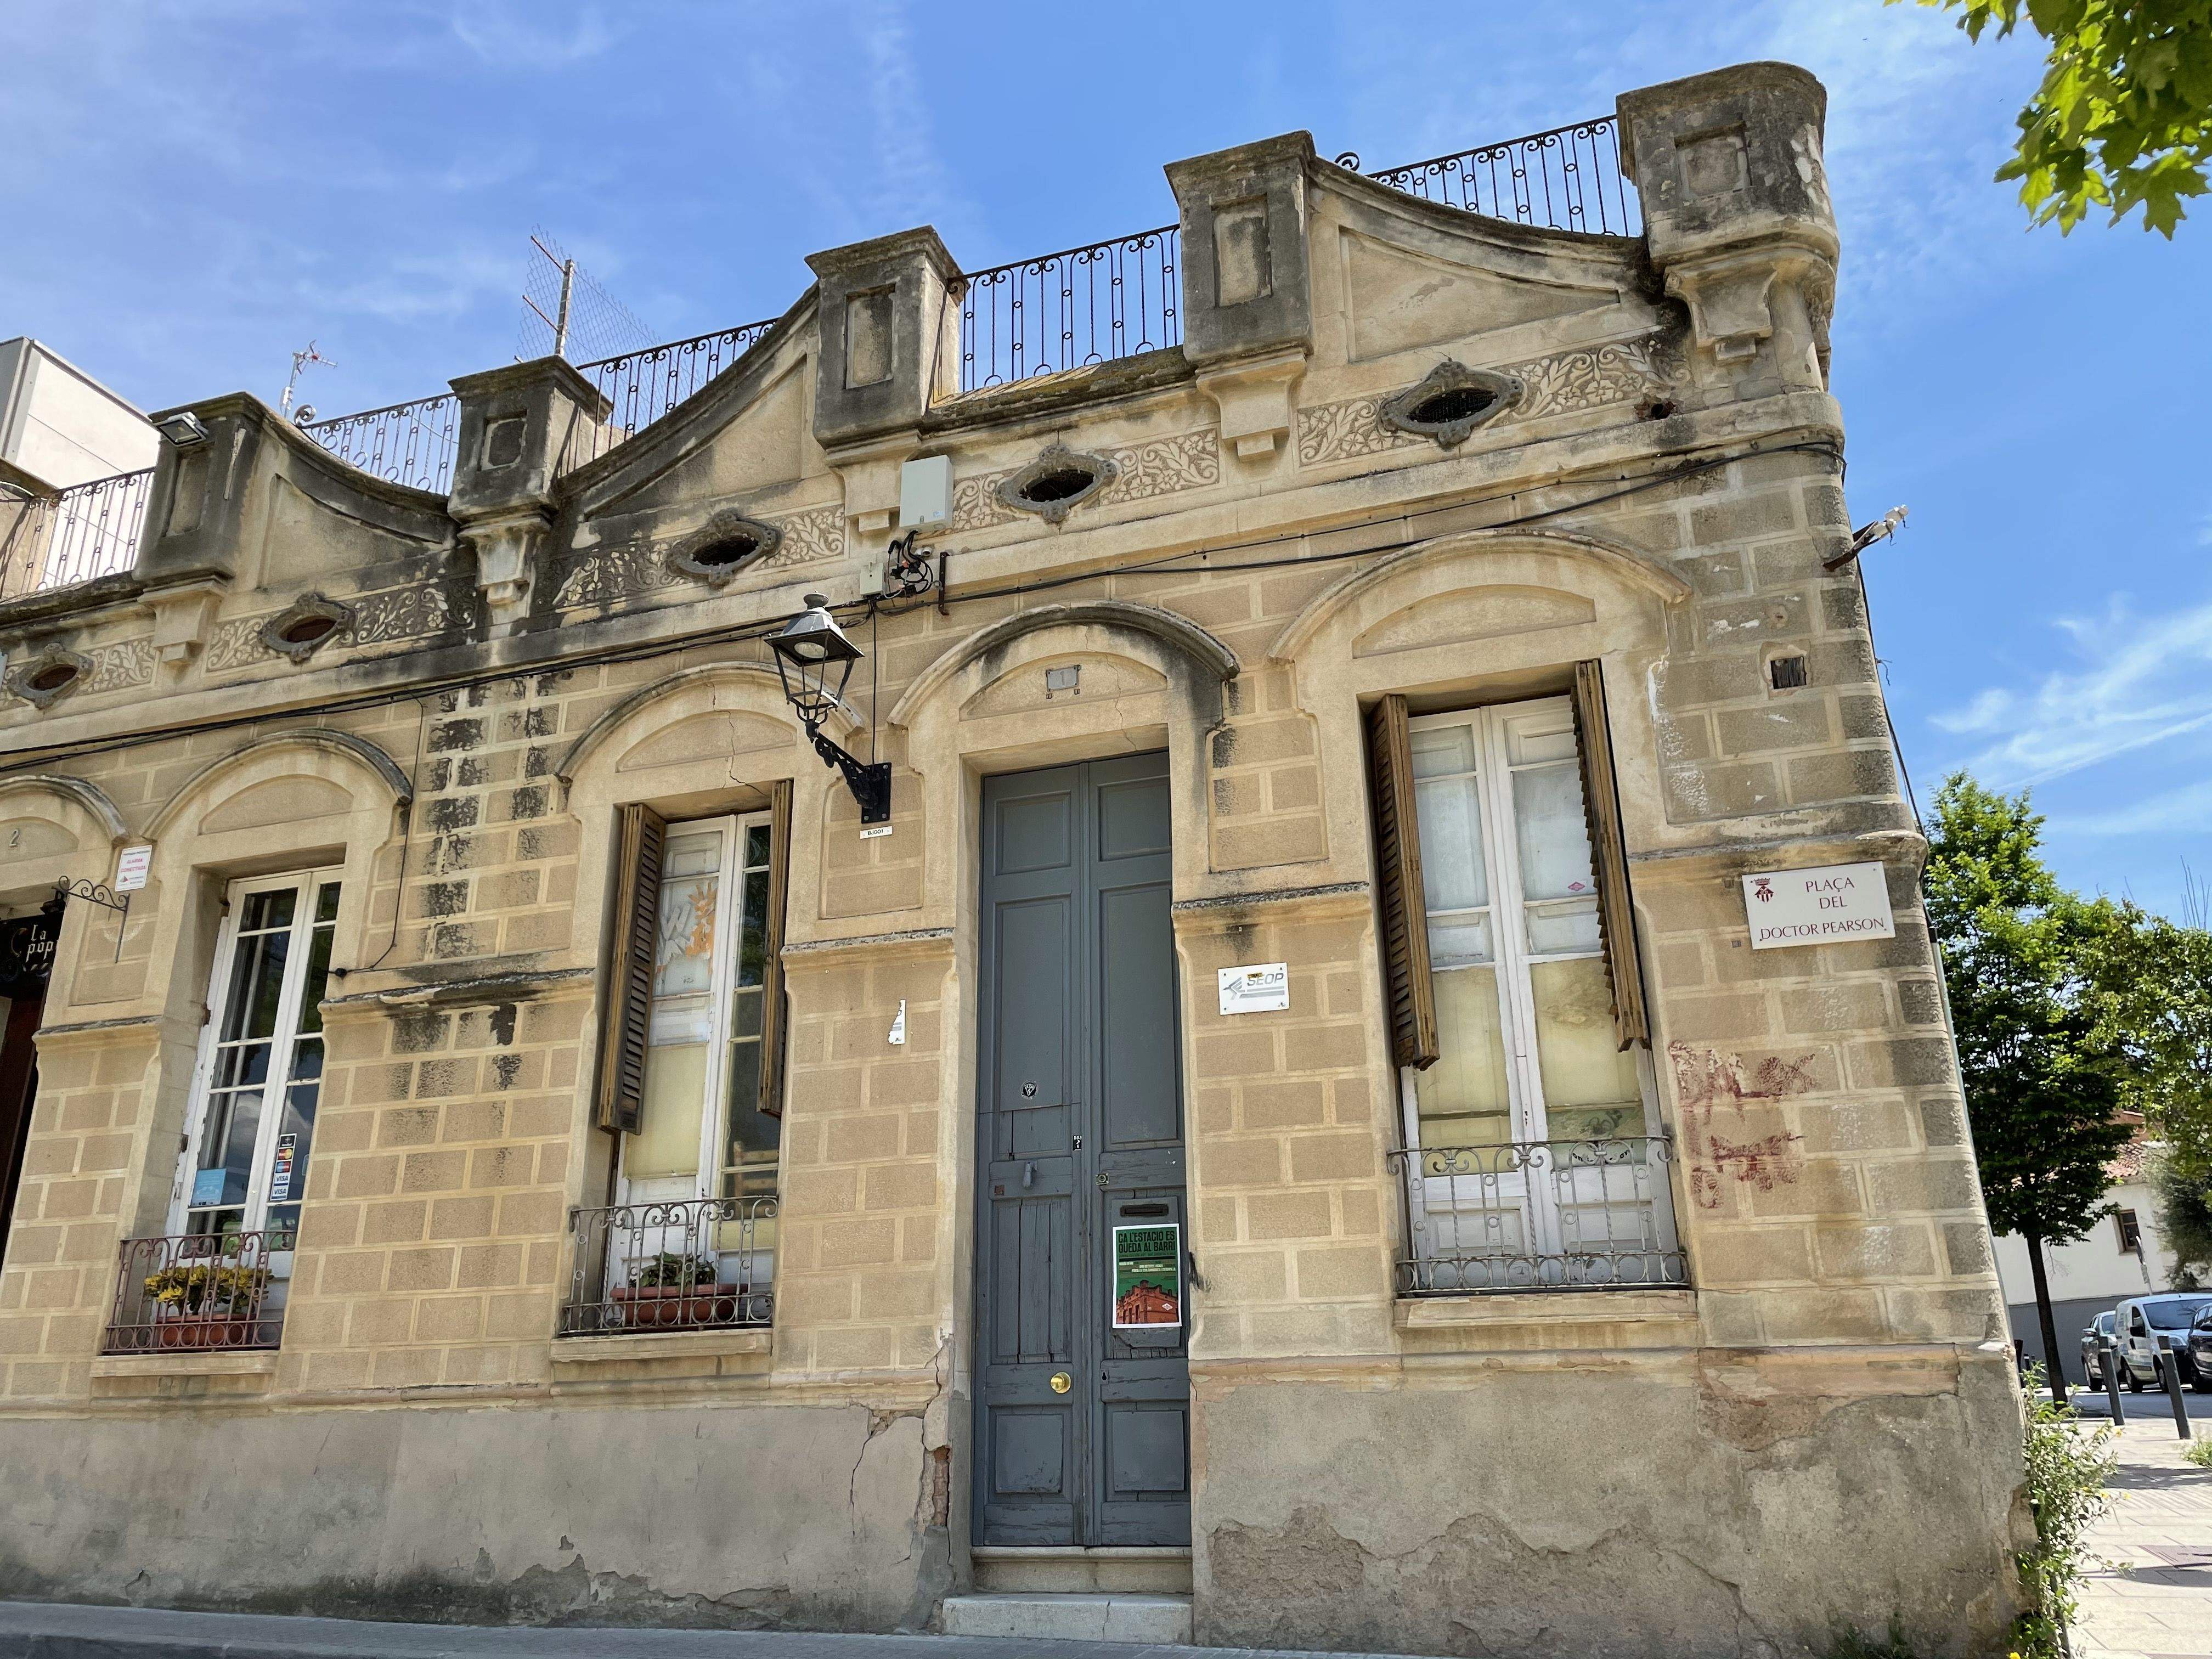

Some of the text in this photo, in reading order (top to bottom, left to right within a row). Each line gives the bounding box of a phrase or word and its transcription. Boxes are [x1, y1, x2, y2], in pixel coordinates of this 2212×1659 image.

[9, 830, 18, 847] 2
[1805, 877, 1854, 893] PLAÇA
[1819, 896, 1848, 910] DEL
[1760, 917, 1884, 940] DOCTOR PEARSON
[1118, 1233, 1128, 1243] CA
[1166, 1231, 1175, 1240] ES
[1143, 1242, 1152, 1252] AL
[1154, 1241, 1176, 1251] BARRI
